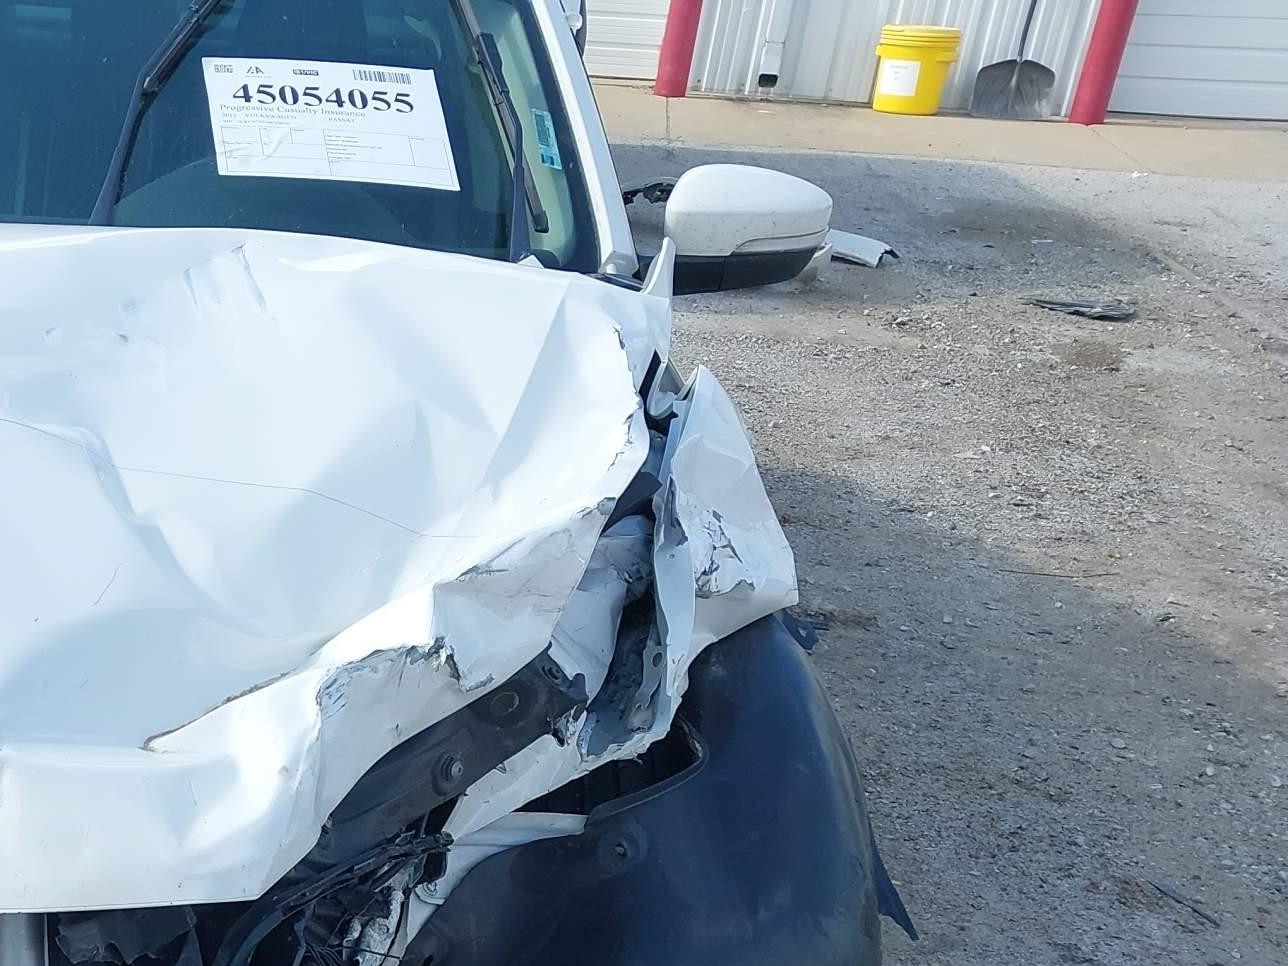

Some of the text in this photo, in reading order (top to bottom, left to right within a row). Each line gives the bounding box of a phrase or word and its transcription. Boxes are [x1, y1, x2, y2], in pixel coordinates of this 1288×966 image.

[232, 83, 414, 113] 45054055
[277, 106, 317, 115] Casualty
[321, 108, 366, 117] Insurance
